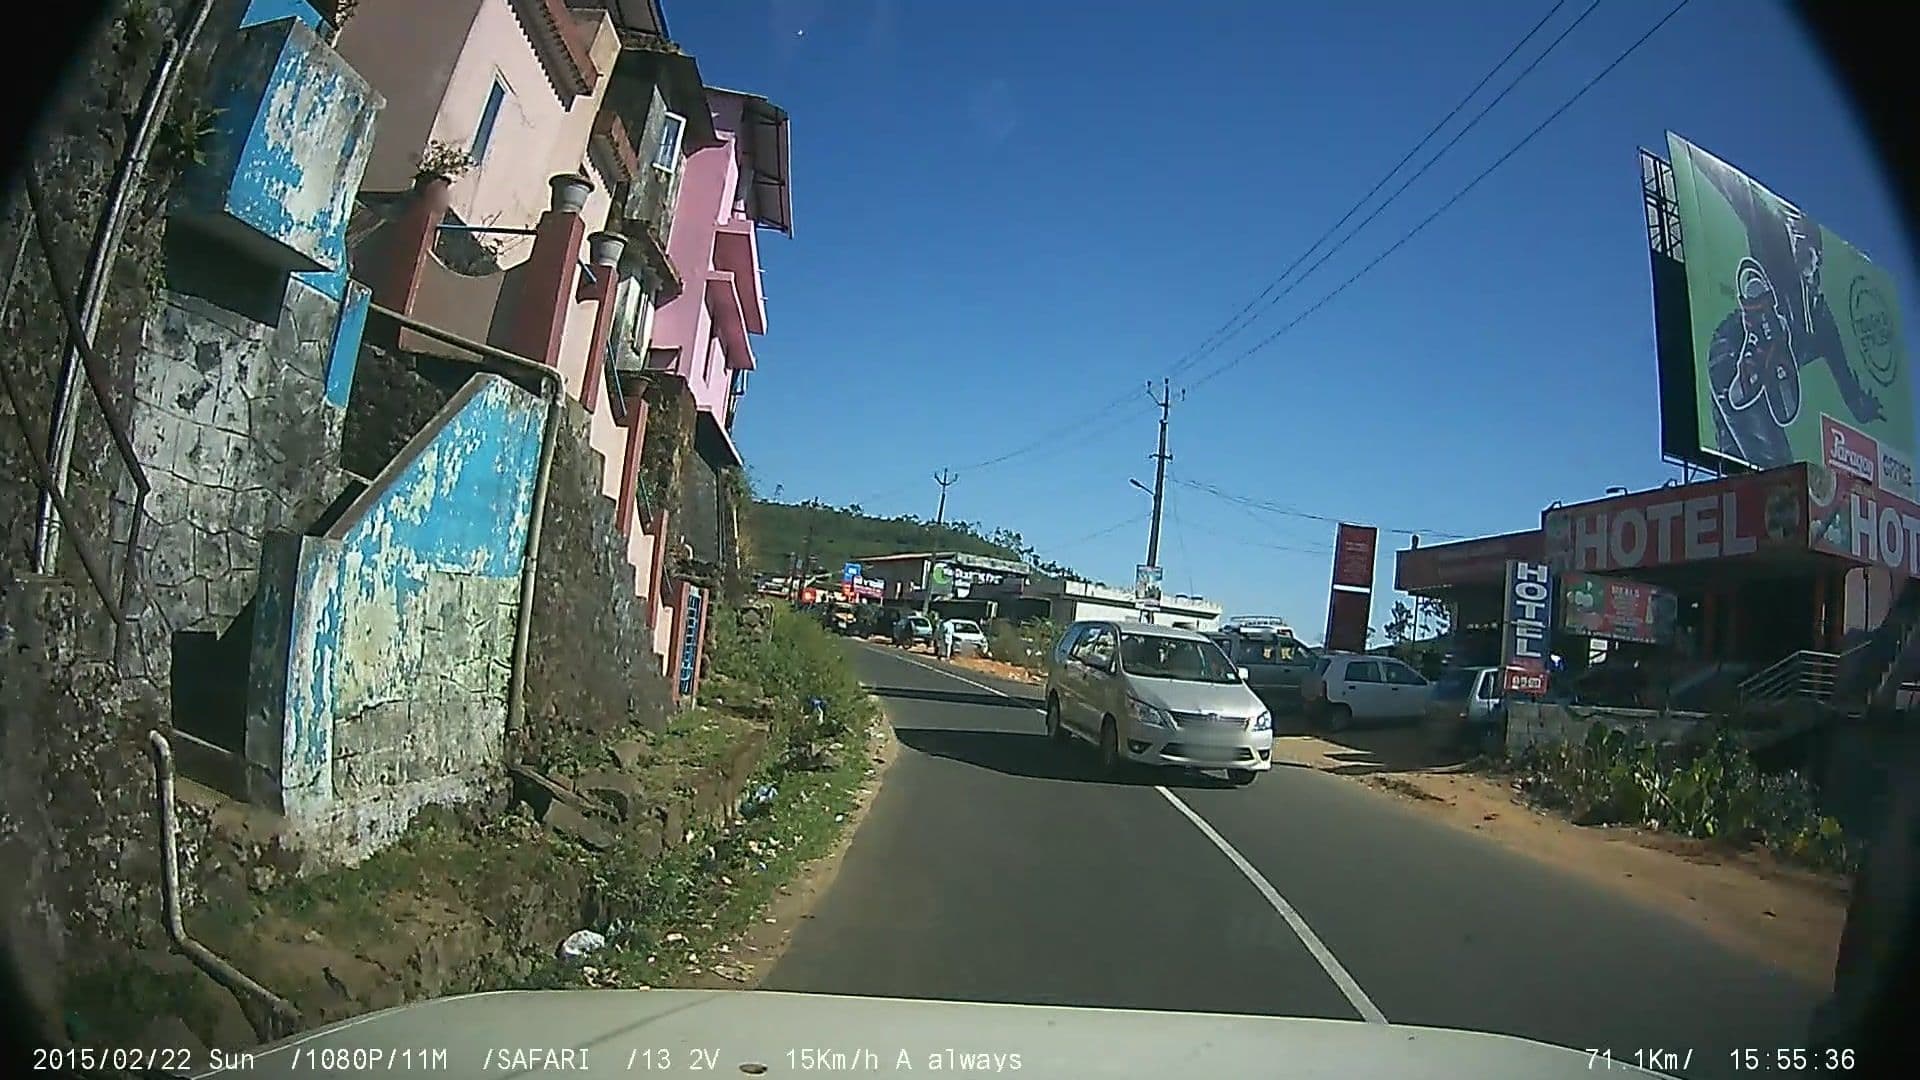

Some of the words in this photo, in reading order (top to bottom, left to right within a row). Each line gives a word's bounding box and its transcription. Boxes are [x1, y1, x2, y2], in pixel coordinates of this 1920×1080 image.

[1829, 428, 1874, 483] Paragon
[1575, 492, 1757, 570] HOTEL
[1515, 562, 1548, 657] HOTEL
